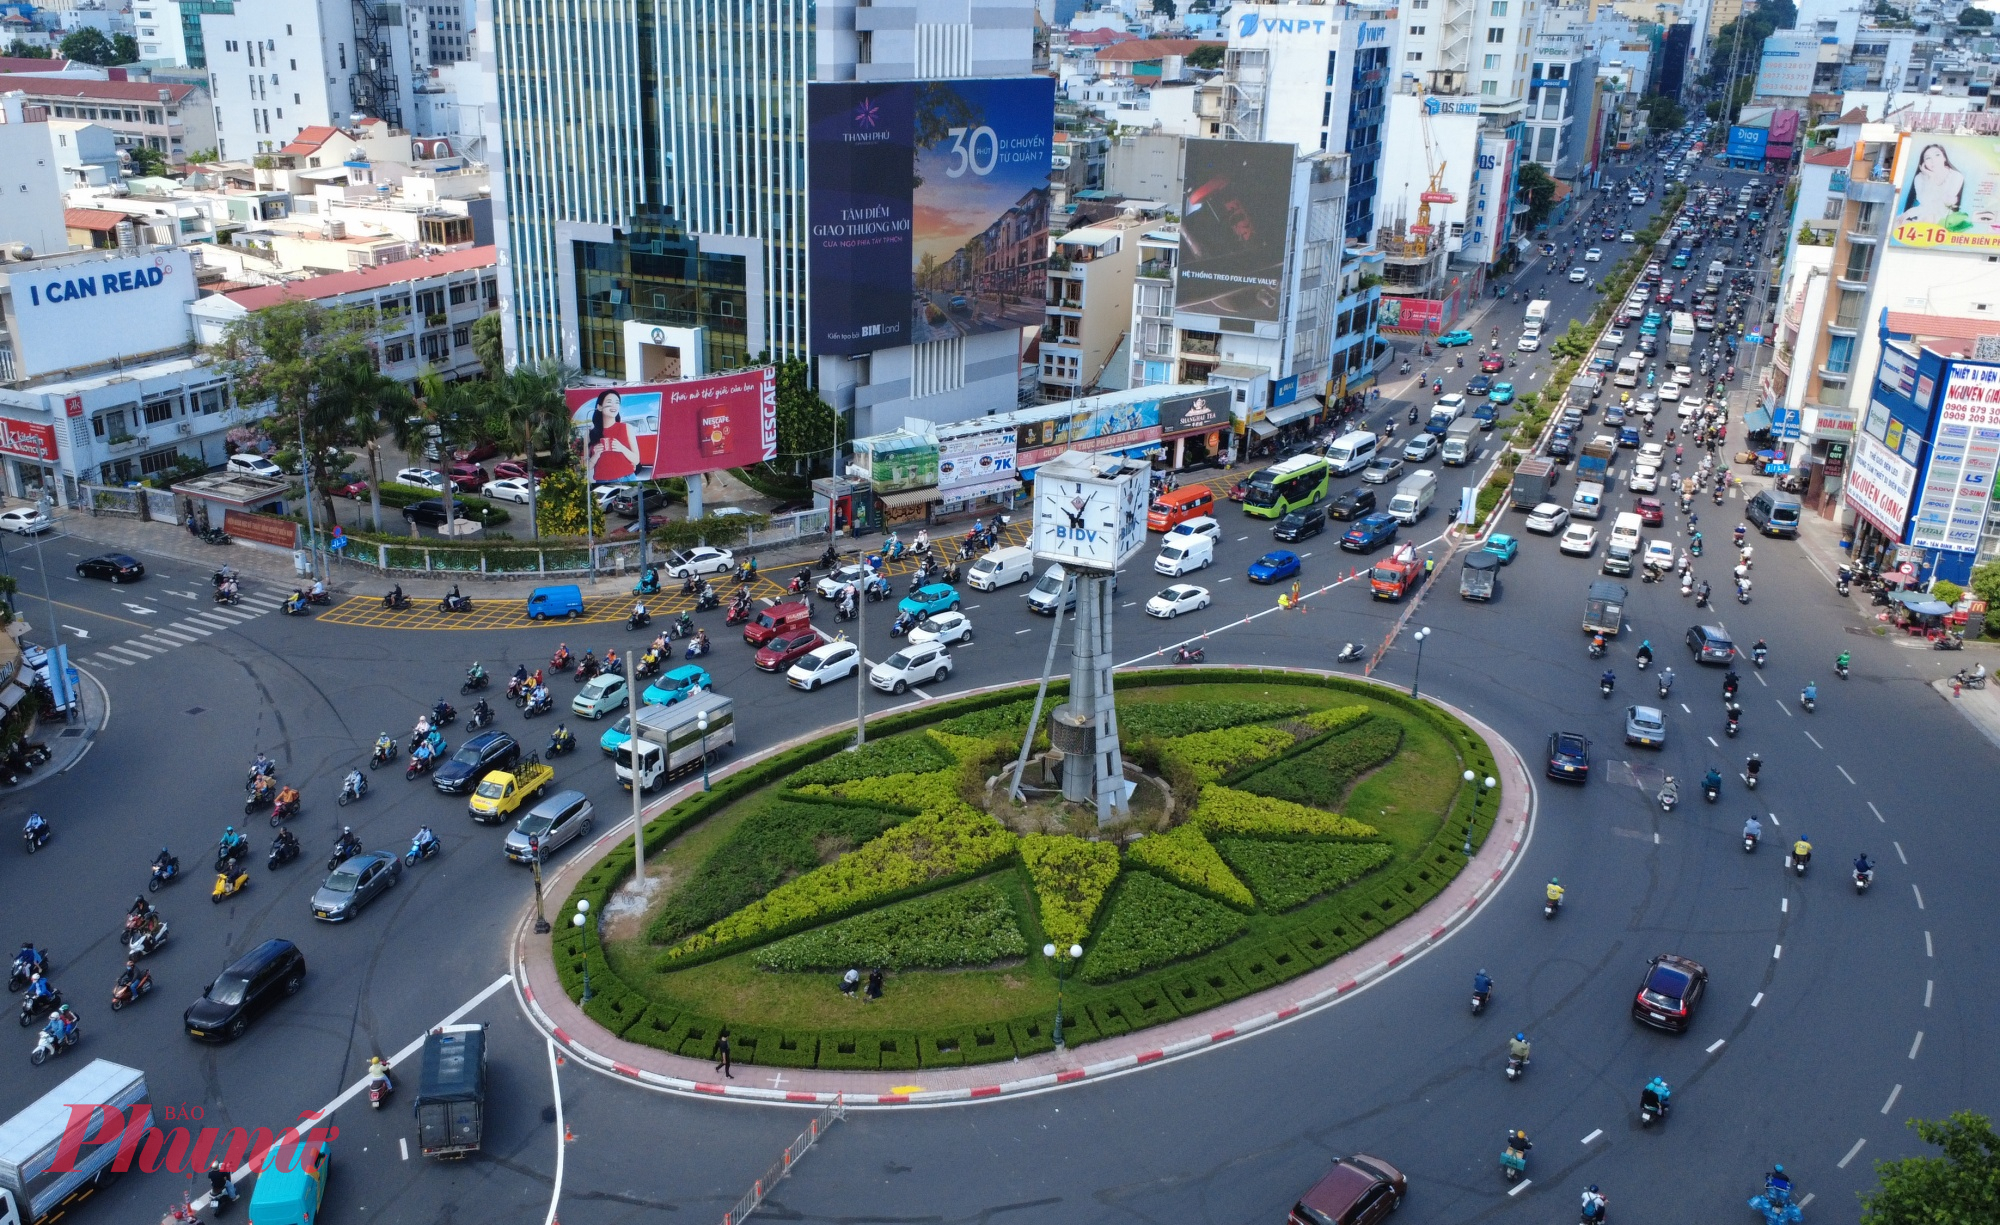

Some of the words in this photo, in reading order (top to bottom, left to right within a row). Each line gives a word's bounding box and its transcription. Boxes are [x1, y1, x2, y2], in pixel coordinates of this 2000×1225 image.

[1262, 19, 1325, 34] VNPT
[1366, 26, 1386, 42] VNPT
[1738, 129, 1759, 143] Diag
[946, 126, 998, 178] 30
[1012, 150, 1037, 163] QUẬN
[1039, 152, 1044, 160] 7
[1479, 154, 1495, 169] QS
[841, 208, 863, 221] TÂM
[813, 224, 845, 236] GIAO
[1897, 226, 1946, 243] 14-16
[1213, 273, 1230, 281] TREO
[1243, 276, 1257, 284] LIVE
[1257, 277, 1277, 285] VALVE
[30, 285, 40, 306] I
[46, 276, 97, 303] CAN
[102, 266, 163, 294] READ
[862, 324, 881, 337] BIM
[1945, 402, 1967, 413] 0906
[1970, 405, 1987, 414] 679
[1207, 412, 1217, 420] TEA
[1943, 410, 1966, 421] 0909
[1968, 413, 1986, 423] 209
[1817, 418, 1836, 429] HOÀI
[1837, 420, 1854, 430] ANH
[994, 458, 1011, 470] 7K
[1935, 454, 1962, 463] MPE
[1965, 474, 1983, 483] LS
[1927, 485, 1954, 493] CADIVI
[1969, 490, 1986, 498] SINO
[1952, 517, 1979, 526] PHILIPS
[1056, 525, 1097, 542] BIDV
[1917, 526, 1944, 536] TOTAL
